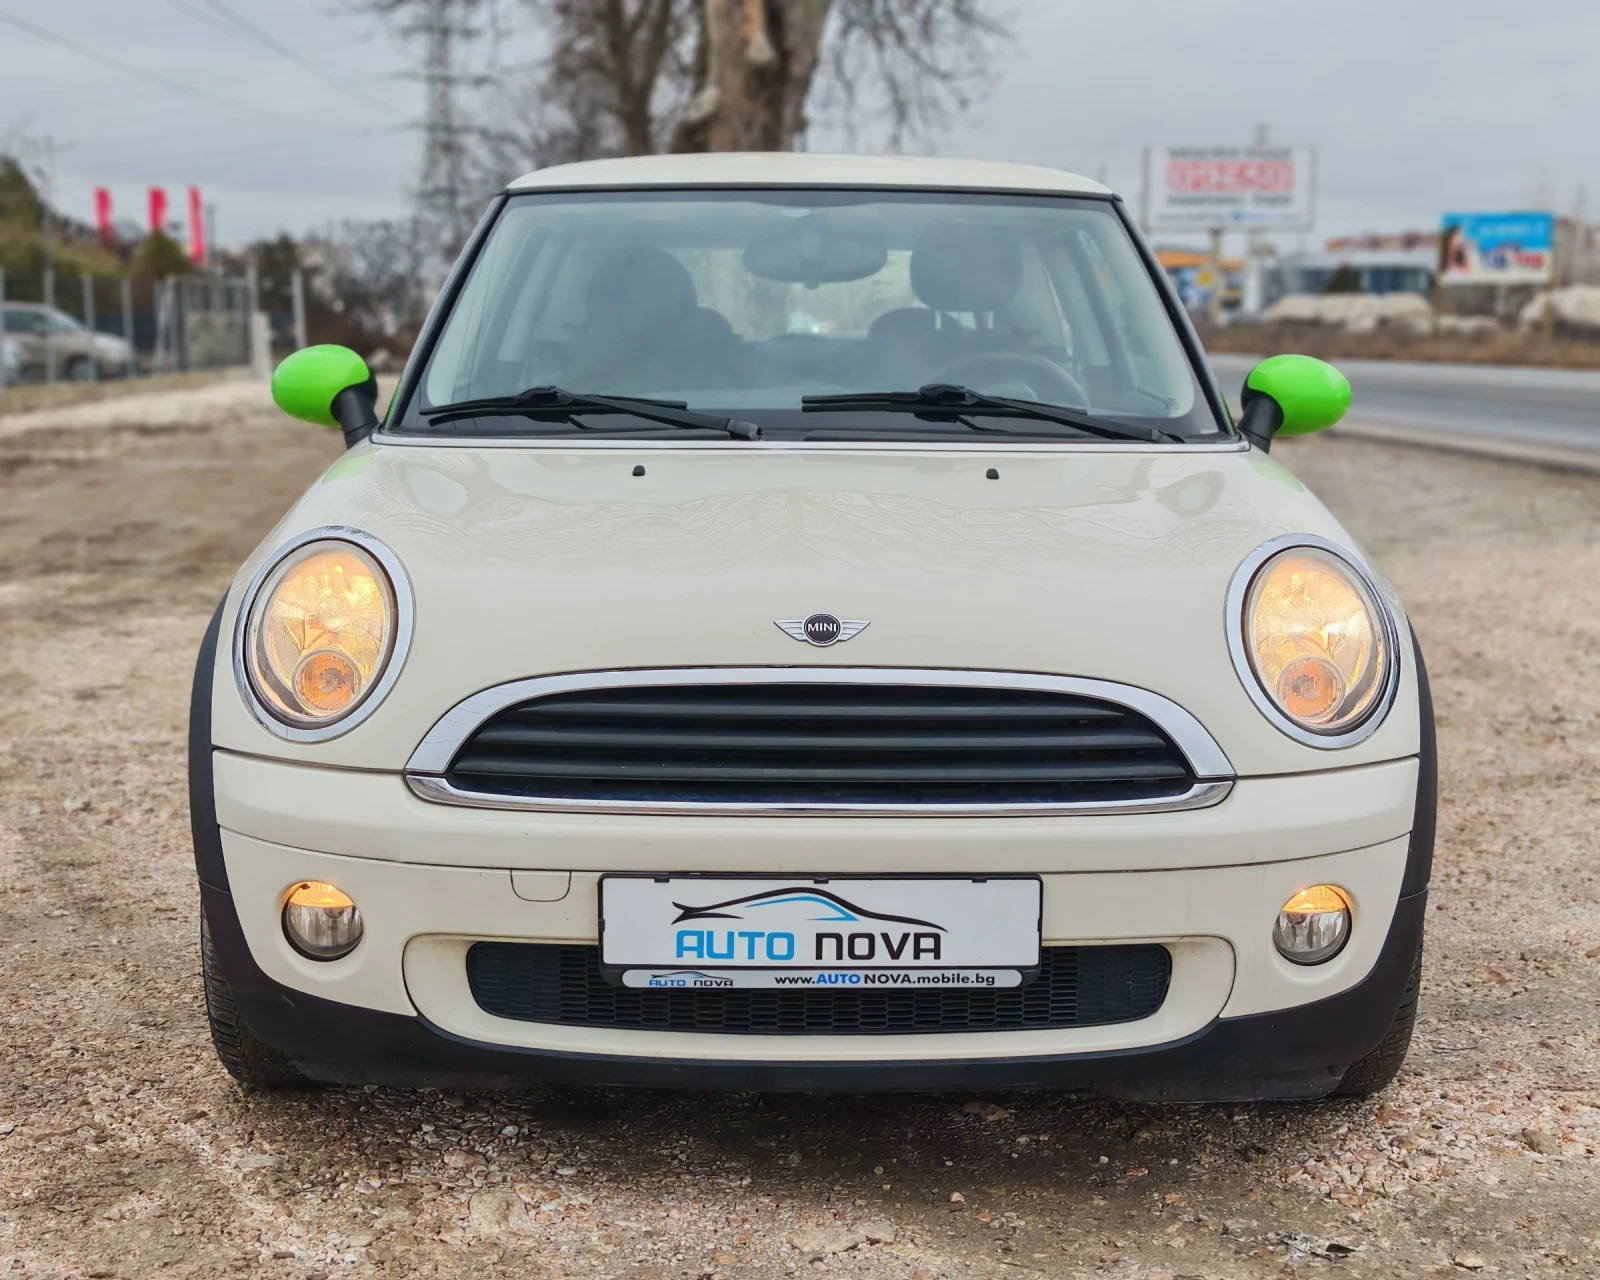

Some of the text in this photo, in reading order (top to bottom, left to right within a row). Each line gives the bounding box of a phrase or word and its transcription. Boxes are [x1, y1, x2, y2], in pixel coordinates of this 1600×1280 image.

[807, 622, 837, 632] MINI
[676, 930, 941, 961] AUTO NOVA
[649, 979, 734, 987] AUTO NOVA
